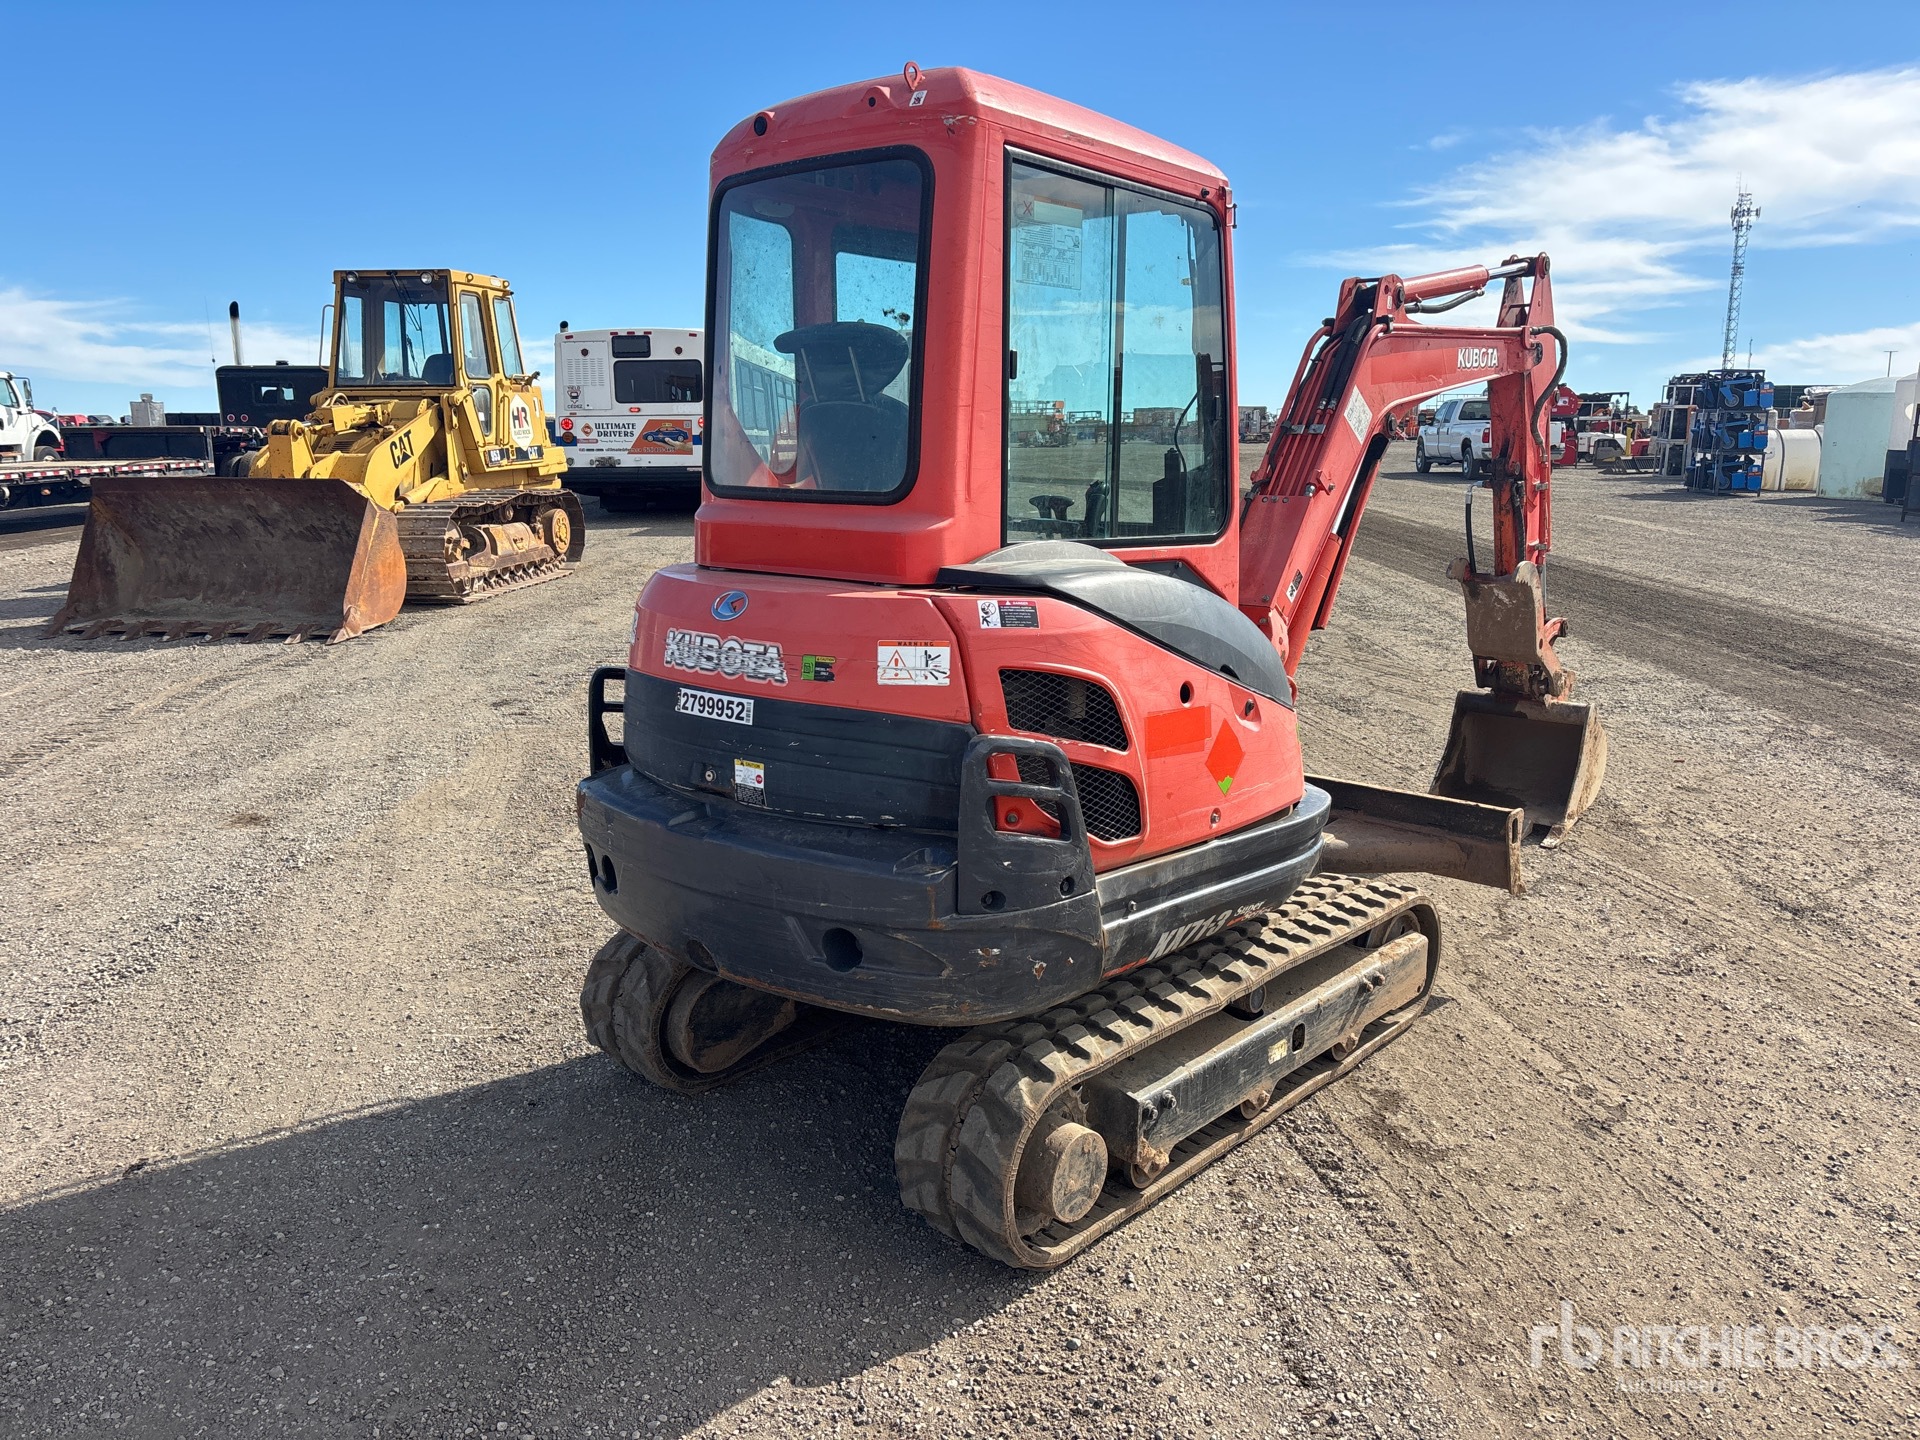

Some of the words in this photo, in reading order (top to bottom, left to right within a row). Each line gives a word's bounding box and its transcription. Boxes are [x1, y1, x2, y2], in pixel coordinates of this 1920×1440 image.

[1457, 347, 1499, 369] KUBOTA
[594, 422, 637, 430] ULTIMATE
[597, 430, 635, 438] DRIVERS
[390, 429, 414, 469] CAT
[528, 447, 538, 459] CAT
[665, 630, 787, 684] KUBOTA
[681, 692, 746, 721] 2799952
[1147, 909, 1232, 962] KX71-3
